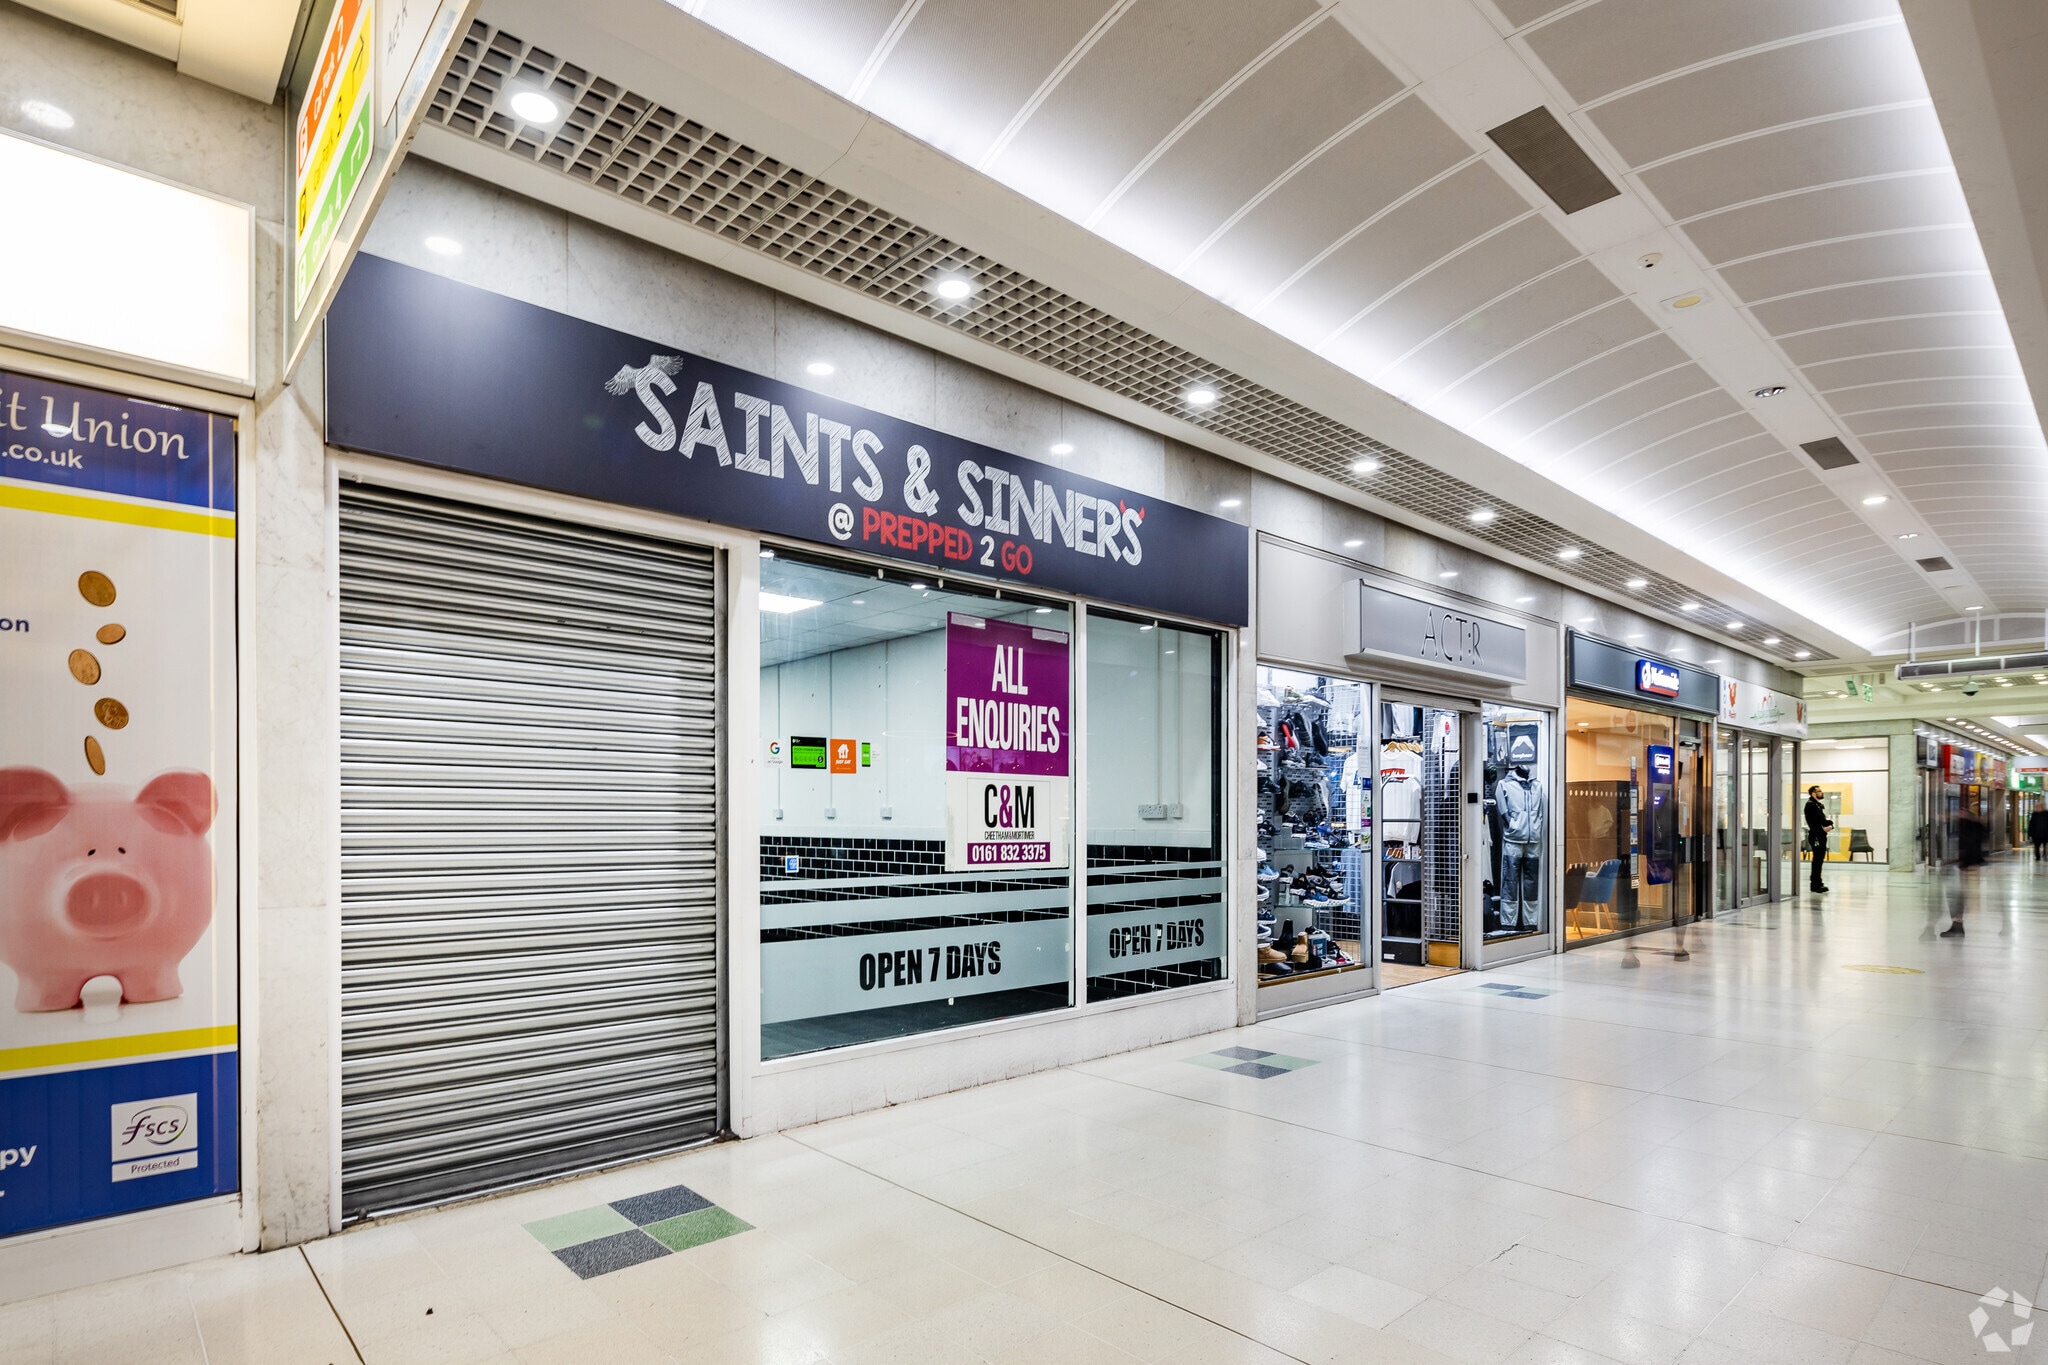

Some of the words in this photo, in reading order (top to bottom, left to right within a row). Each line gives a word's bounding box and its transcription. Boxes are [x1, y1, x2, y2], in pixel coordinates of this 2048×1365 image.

[336, 15, 344, 62] 2
[336, 95, 342, 138] 3
[335, 171, 342, 211] 4
[40, 395, 190, 460] Union
[634, 365, 885, 503] SAINTS
[903, 444, 940, 517] &
[827, 502, 855, 541] @
[863, 506, 973, 561] PREPPED
[979, 535, 995, 567] 2
[1001, 540, 1033, 575] GO
[991, 644, 1028, 695] ALL
[956, 696, 1060, 753] ENQUIRIES
[984, 783, 1035, 828] C&M
[972, 845, 997, 862] 0161
[1000, 845, 1020, 861] 832
[1021, 843, 1046, 860] 3375
[1109, 923, 1151, 959] OPEN
[1155, 924, 1163, 952] 7
[1166, 918, 1204, 950] DAYS
[859, 948, 923, 991] OPEN
[928, 947, 941, 982] 7
[946, 940, 1001, 981] DAYS
[0, 1145, 37, 1170] py
[131, 1157, 180, 1174] Protected
